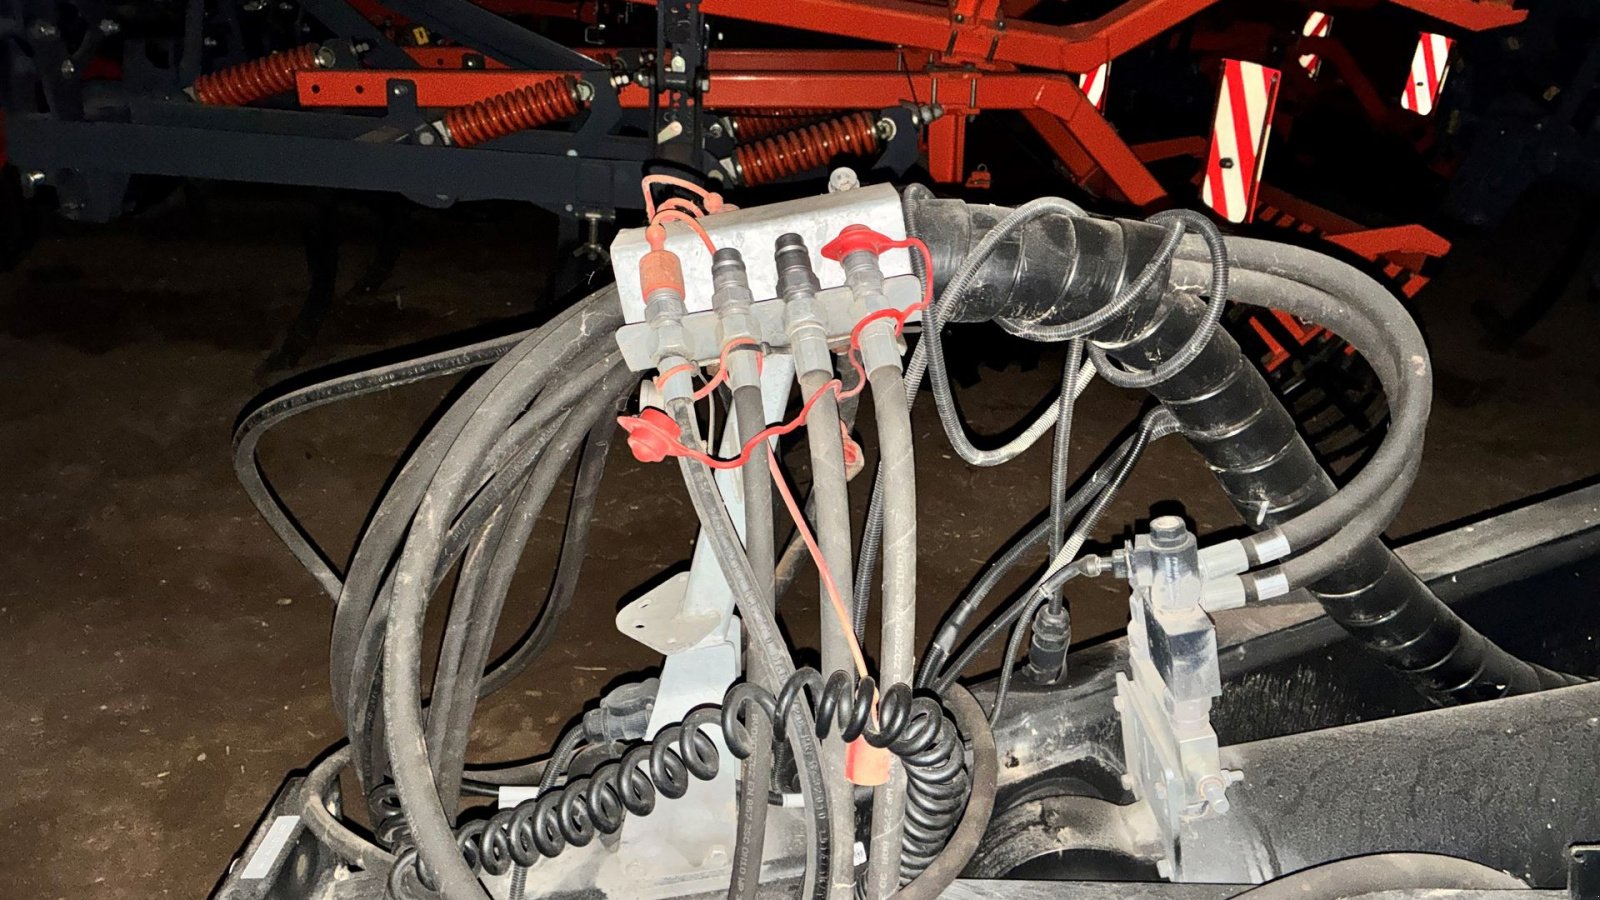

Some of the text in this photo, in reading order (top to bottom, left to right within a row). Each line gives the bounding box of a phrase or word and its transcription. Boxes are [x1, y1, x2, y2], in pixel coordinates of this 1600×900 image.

[747, 781, 755, 796] EN
[744, 798, 754, 821] 857
[742, 823, 752, 845] 2SC
[739, 846, 749, 874] DN10
[737, 876, 746, 892] WP
